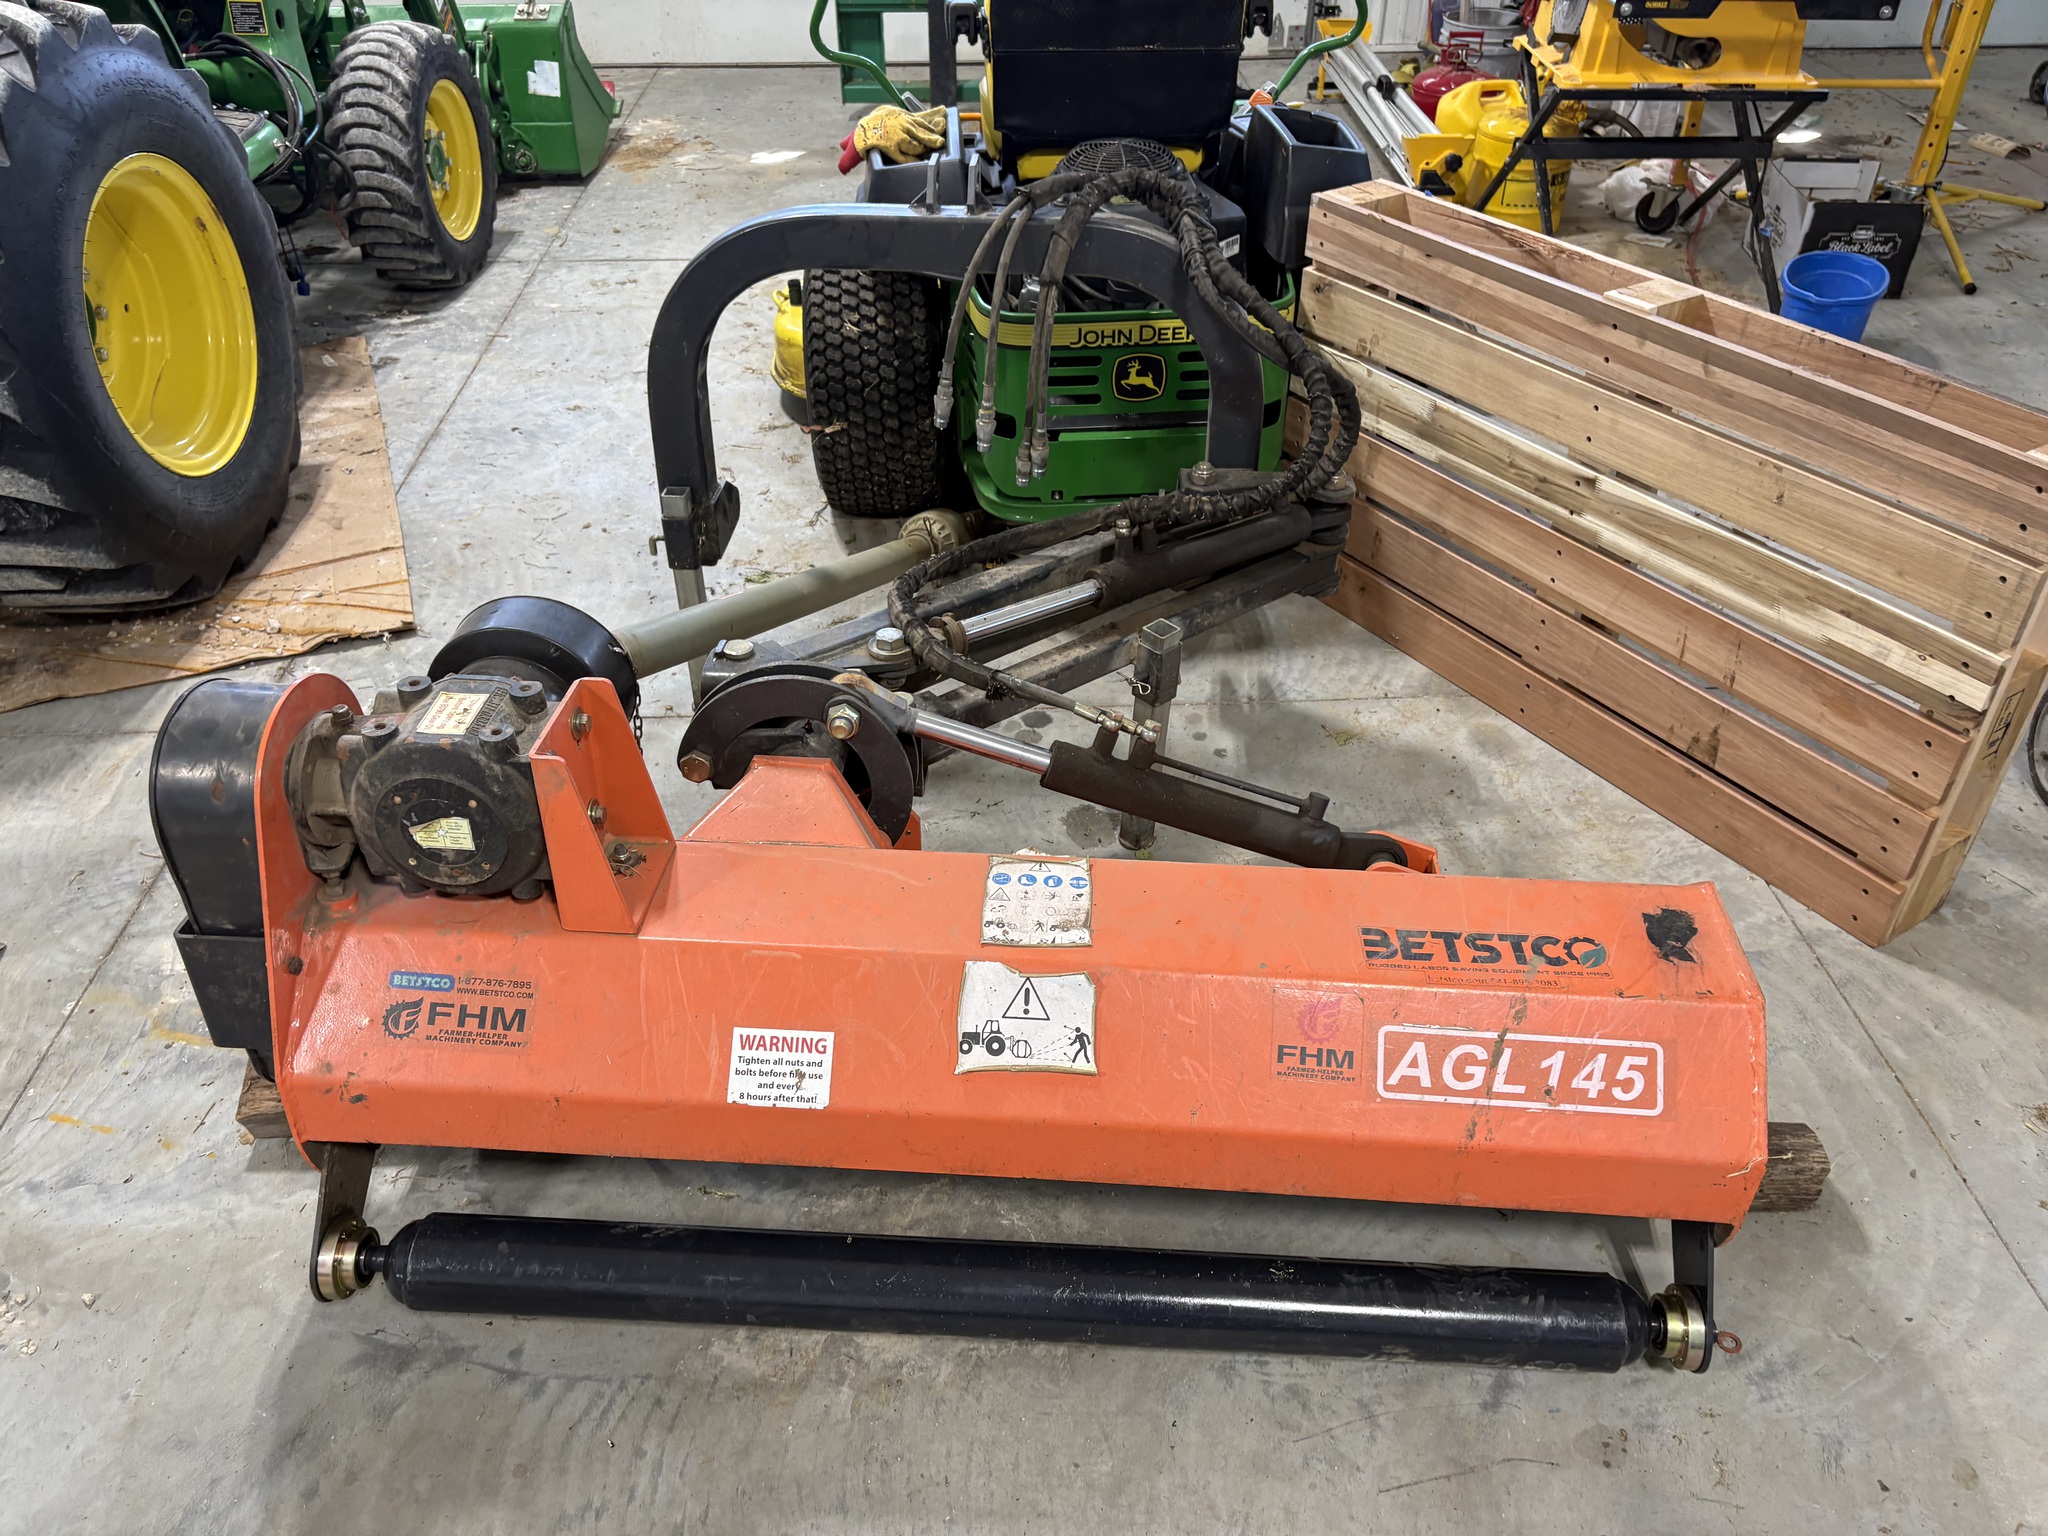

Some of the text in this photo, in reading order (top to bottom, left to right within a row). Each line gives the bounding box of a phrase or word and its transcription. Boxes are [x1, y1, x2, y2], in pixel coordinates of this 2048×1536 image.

[1829, 240, 1893, 254] Black Label
[1070, 327, 1132, 346] JOHN
[1361, 928, 1607, 968] BETSTCO
[393, 974, 532, 990] BETSTCO 1-877-876-7895
[456, 987, 534, 1000] WWW.BETSTCO.COM
[427, 1001, 527, 1033] FHM
[425, 1034, 523, 1048] MACHINERY COMPANY
[438, 1029, 508, 1040] FARMER-HELPER
[739, 1034, 828, 1054] WARNING
[738, 1055, 823, 1068] Tighten all nuts and
[1277, 1044, 1355, 1070] FHM
[735, 1067, 757, 1076] bolts
[758, 1068, 788, 1078] before
[808, 1072, 824, 1080] use
[1277, 1071, 1356, 1082] MACHINERY COMPANY
[1287, 1066, 1344, 1076] FARMER-HELPER
[1386, 1041, 1649, 1101] AGL 145
[757, 1081, 774, 1089] and
[739, 1092, 818, 1104] 8 hours after that!
